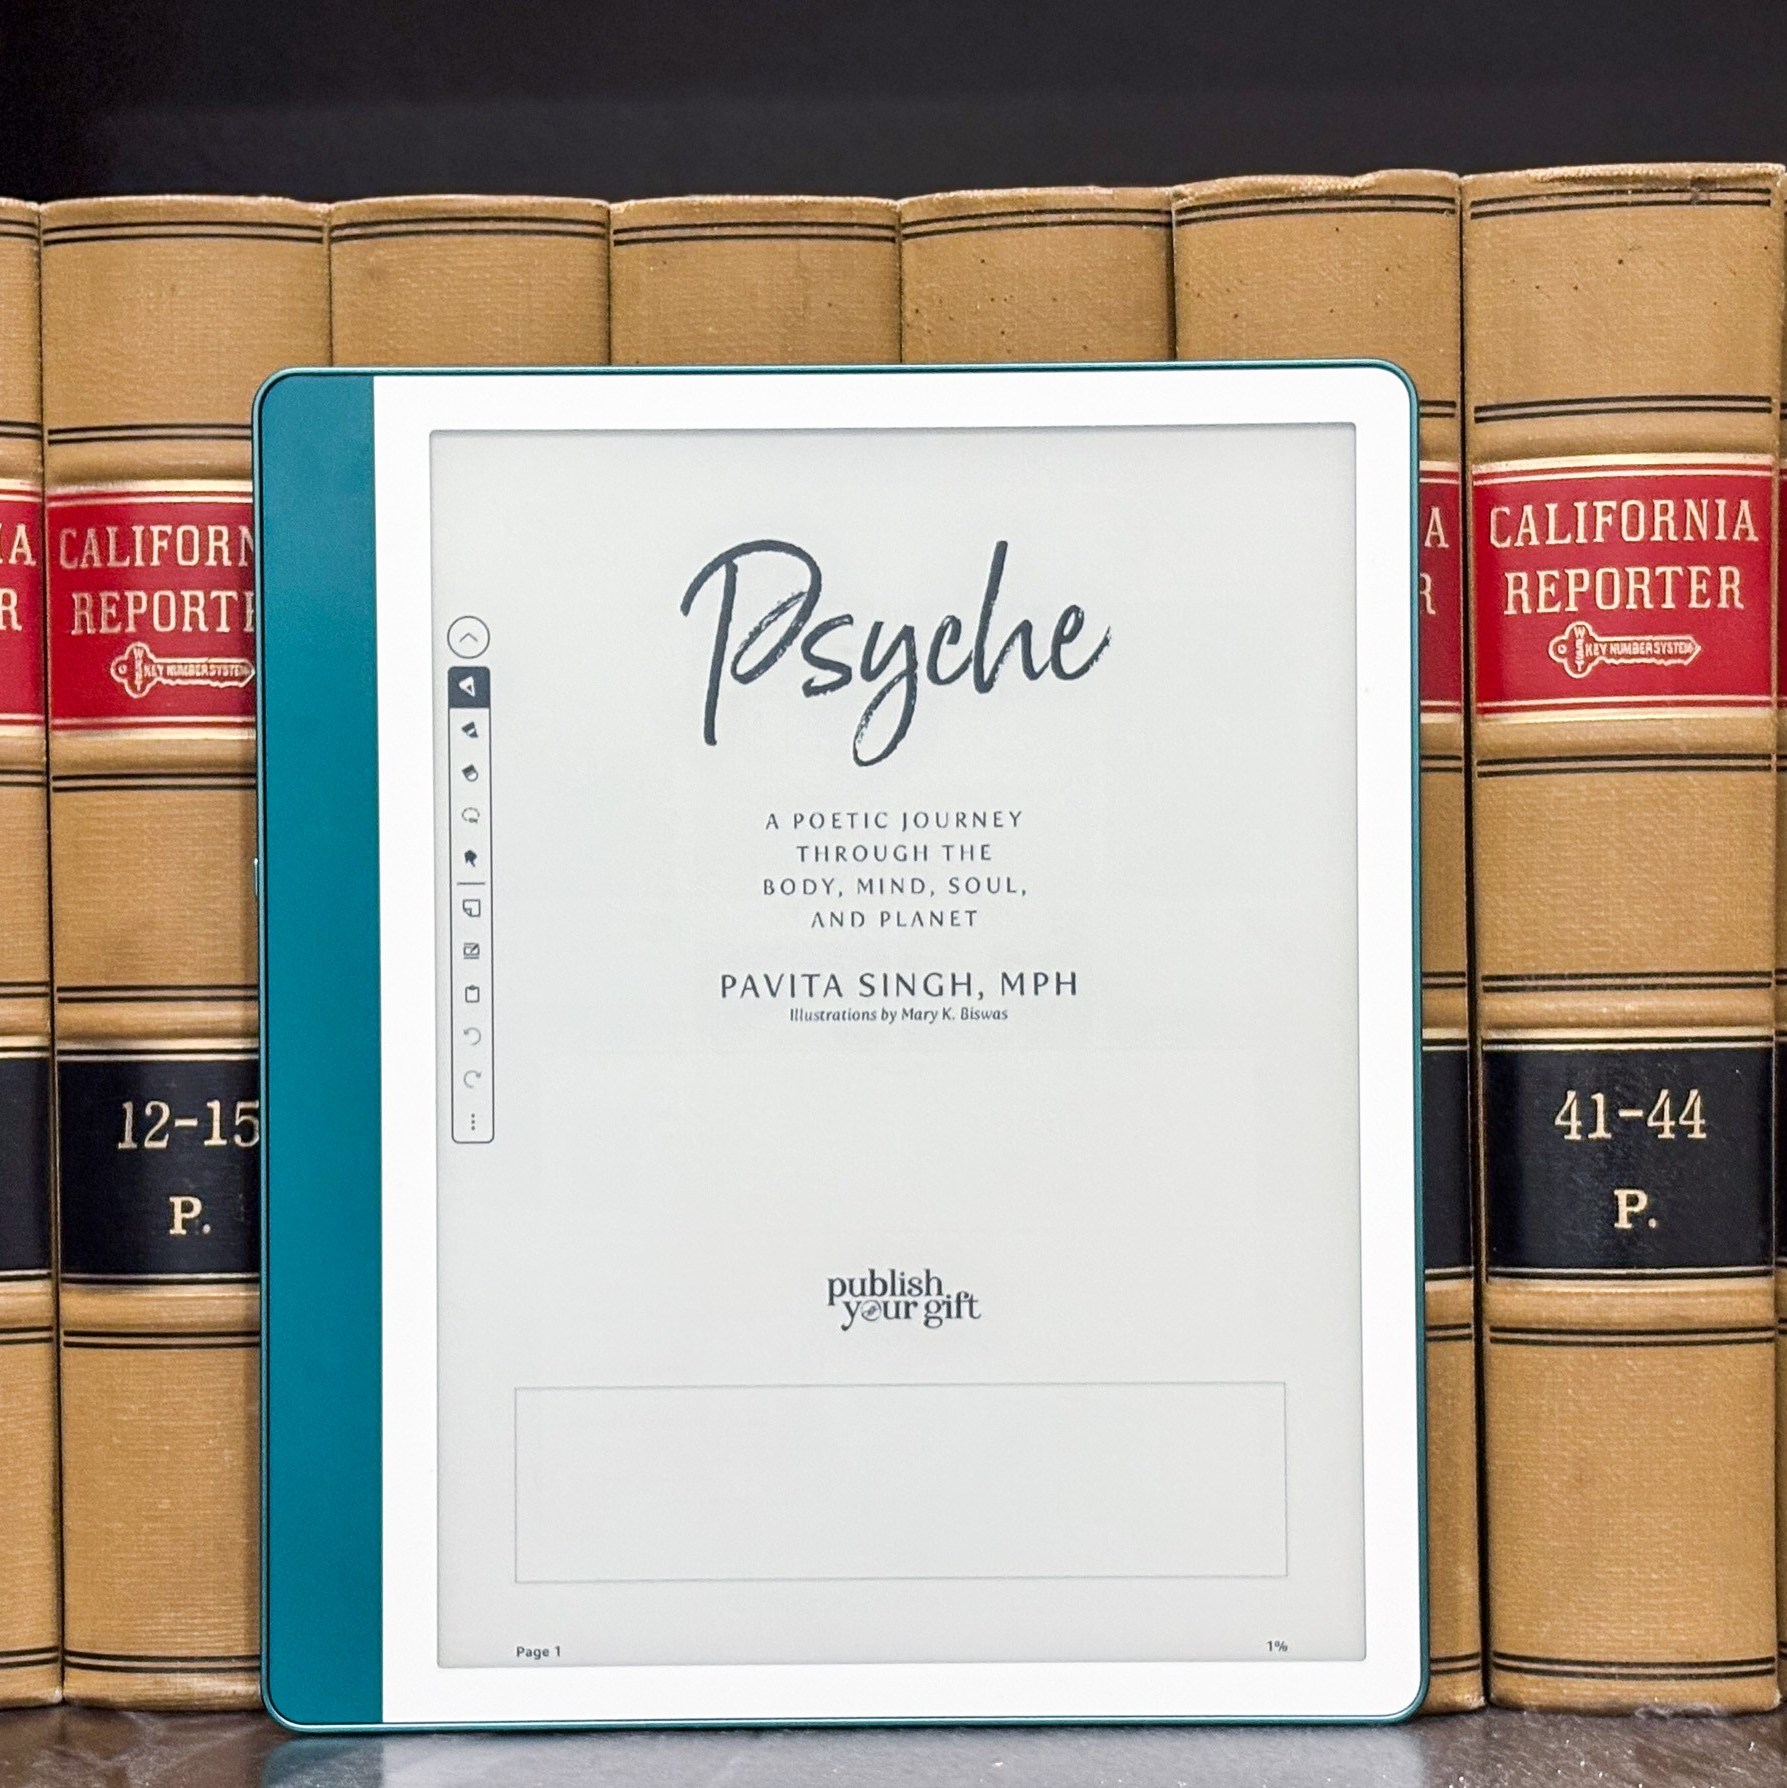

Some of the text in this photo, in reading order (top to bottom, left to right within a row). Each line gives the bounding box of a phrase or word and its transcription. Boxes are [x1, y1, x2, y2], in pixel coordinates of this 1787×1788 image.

[1489, 498, 1759, 549] CALIFORNIA
[1503, 565, 1745, 615] REPORTER
[680, 539, 1111, 767] Psyche
[1610, 641, 1653, 655] NUMBER
[1654, 641, 1693, 655] SYSTEM
[766, 810, 1022, 833] A POETIC JOURNEY
[796, 843, 992, 863] THROUGH THE
[763, 876, 1027, 898] BODY, MIND, SOUL,
[811, 909, 978, 929] AND PLANET
[720, 970, 1077, 1001] PAVITA SINGH, MPH
[790, 1006, 1009, 1025] Illustrations by Mary K. Biswas
[117, 1099, 259, 1149] 12-15
[1554, 1088, 1707, 1140] 41-44
[169, 1196, 211, 1235] P.
[1613, 1188, 1658, 1230] P.
[827, 1268, 944, 1306] publish
[841, 1290, 982, 1331] your gift
[516, 1646, 561, 1661] Page 1
[1267, 1640, 1288, 1652] 1%
